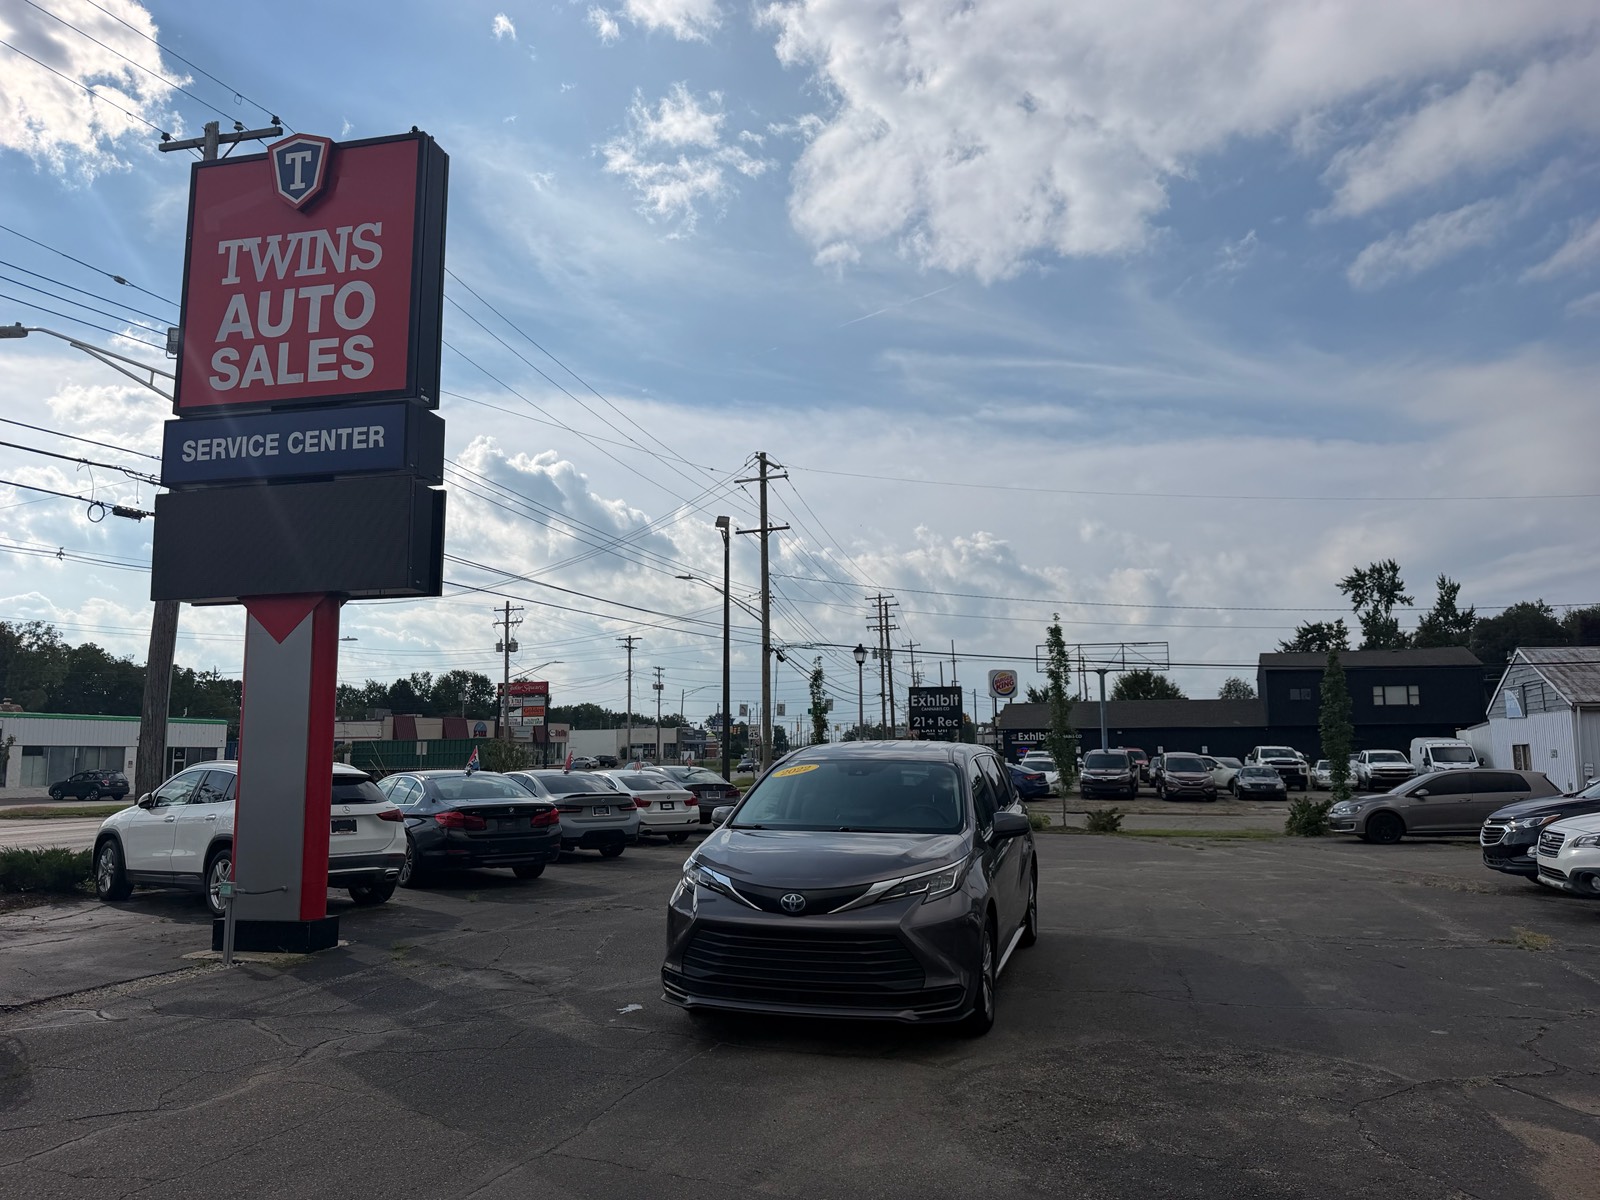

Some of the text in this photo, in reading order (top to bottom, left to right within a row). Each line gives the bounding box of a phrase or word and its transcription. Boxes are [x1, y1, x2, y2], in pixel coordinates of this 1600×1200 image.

[285, 150, 312, 190] T
[217, 221, 383, 286] TWINS
[215, 280, 376, 343] AUTO
[208, 335, 375, 391] SALES
[181, 425, 385, 463] SERVICE CENTER
[521, 683, 545, 692] Square
[995, 675, 1014, 690] BURGER KING
[913, 716, 959, 727] 21+ Rec
[781, 765, 812, 776] 2022
